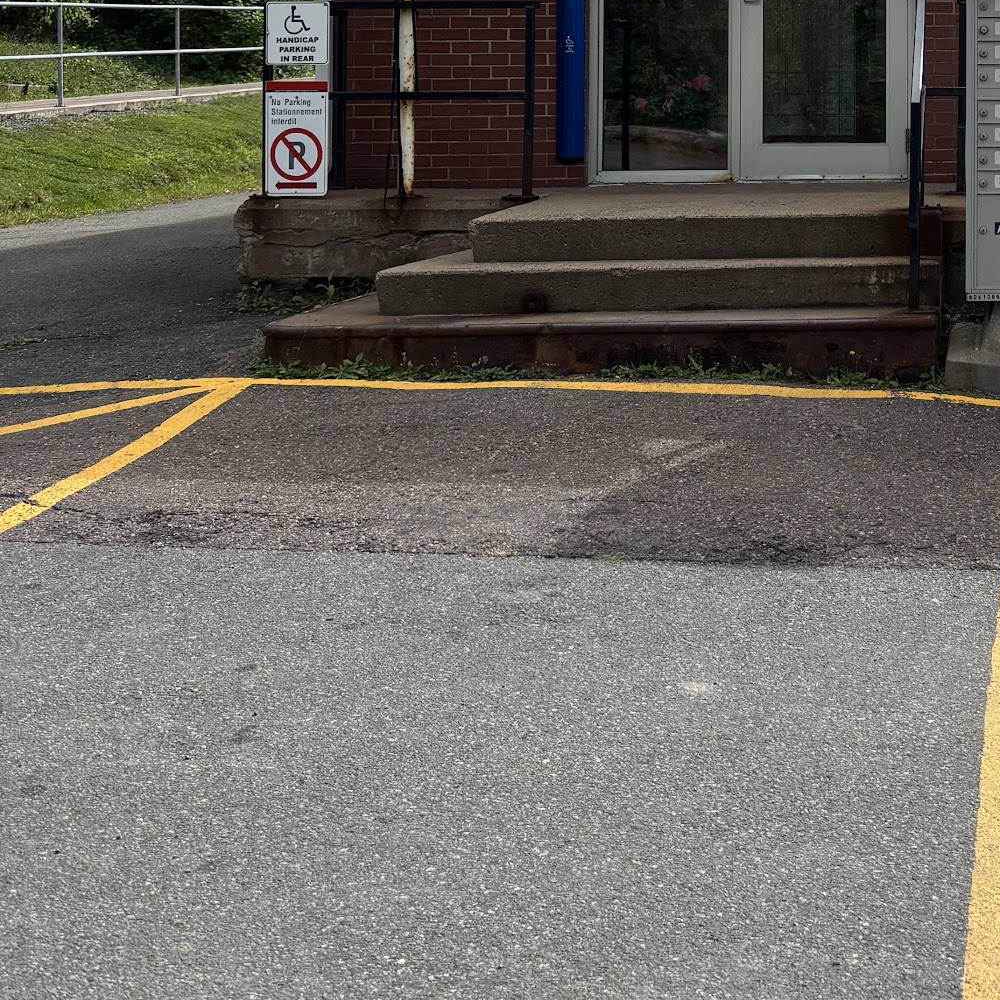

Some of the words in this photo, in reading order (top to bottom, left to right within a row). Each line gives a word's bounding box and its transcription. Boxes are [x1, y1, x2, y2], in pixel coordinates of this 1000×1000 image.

[276, 36, 320, 44] HANDICAP
[271, 98, 281, 106] No
[284, 98, 311, 107] Parking
[271, 108, 322, 116] Stationnement
